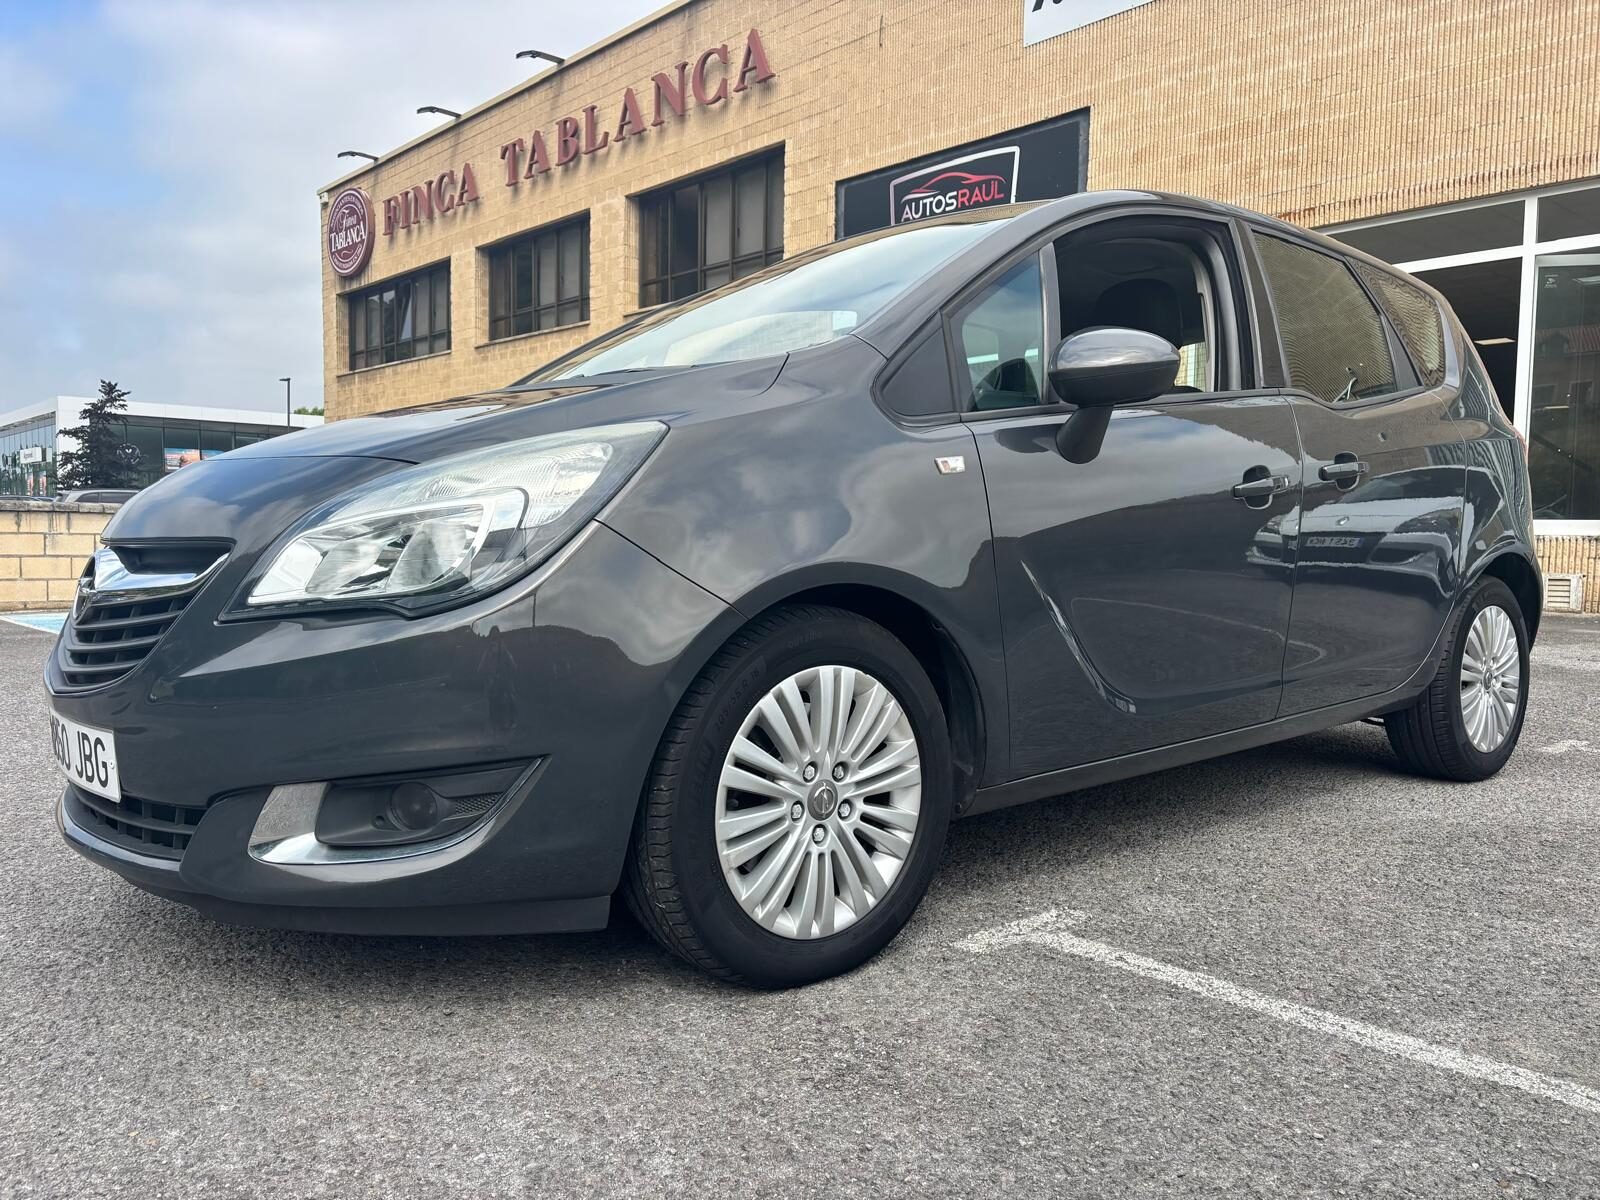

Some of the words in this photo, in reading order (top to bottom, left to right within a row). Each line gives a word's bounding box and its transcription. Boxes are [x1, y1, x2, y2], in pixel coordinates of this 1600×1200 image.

[383, 162, 480, 235] FINCA
[500, 28, 776, 187] TABLANCA
[330, 220, 366, 252] TABLANCA
[75, 731, 108, 788] JBG
